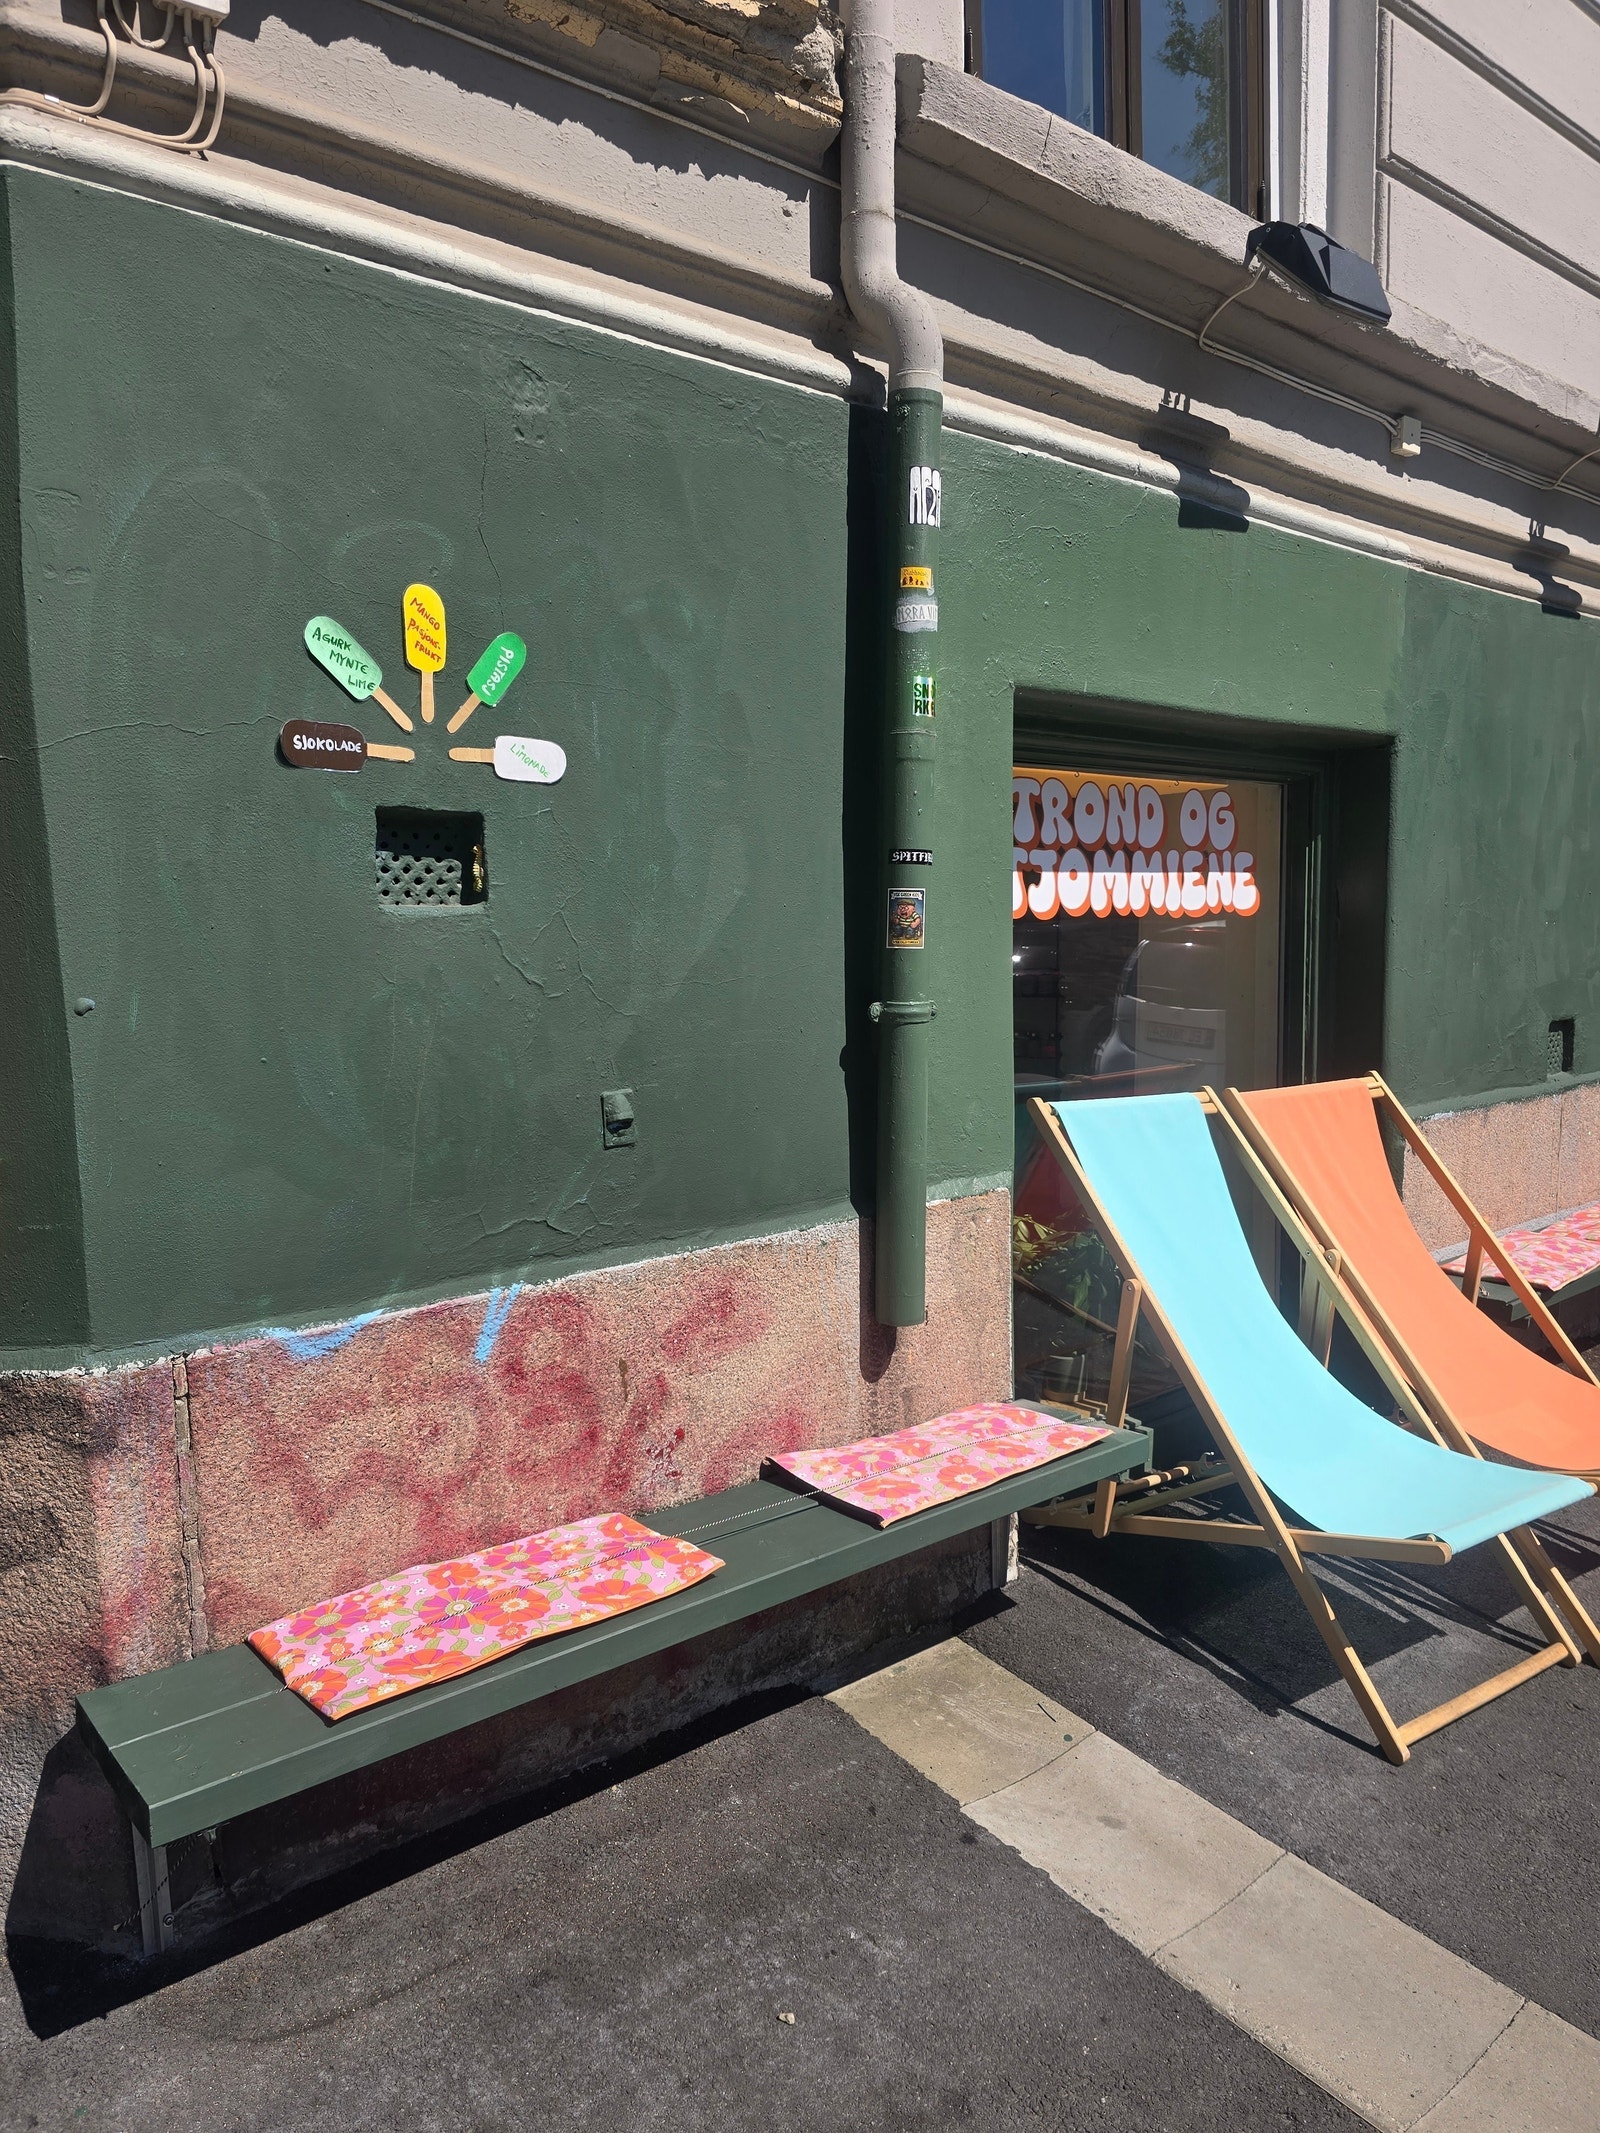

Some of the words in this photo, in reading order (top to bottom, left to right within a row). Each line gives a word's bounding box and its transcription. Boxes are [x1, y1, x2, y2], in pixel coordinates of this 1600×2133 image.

[409, 597, 441, 631] MANGO
[312, 626, 353, 652] AGURK
[414, 640, 442, 663] FRUKT
[329, 649, 369, 675] MYNTE
[481, 646, 515, 697] PISTASJ
[347, 674, 376, 691] LIME
[292, 734, 363, 753] SJOKOLADE
[1013, 776, 1166, 850] TROND
[1180, 788, 1238, 852] OG
